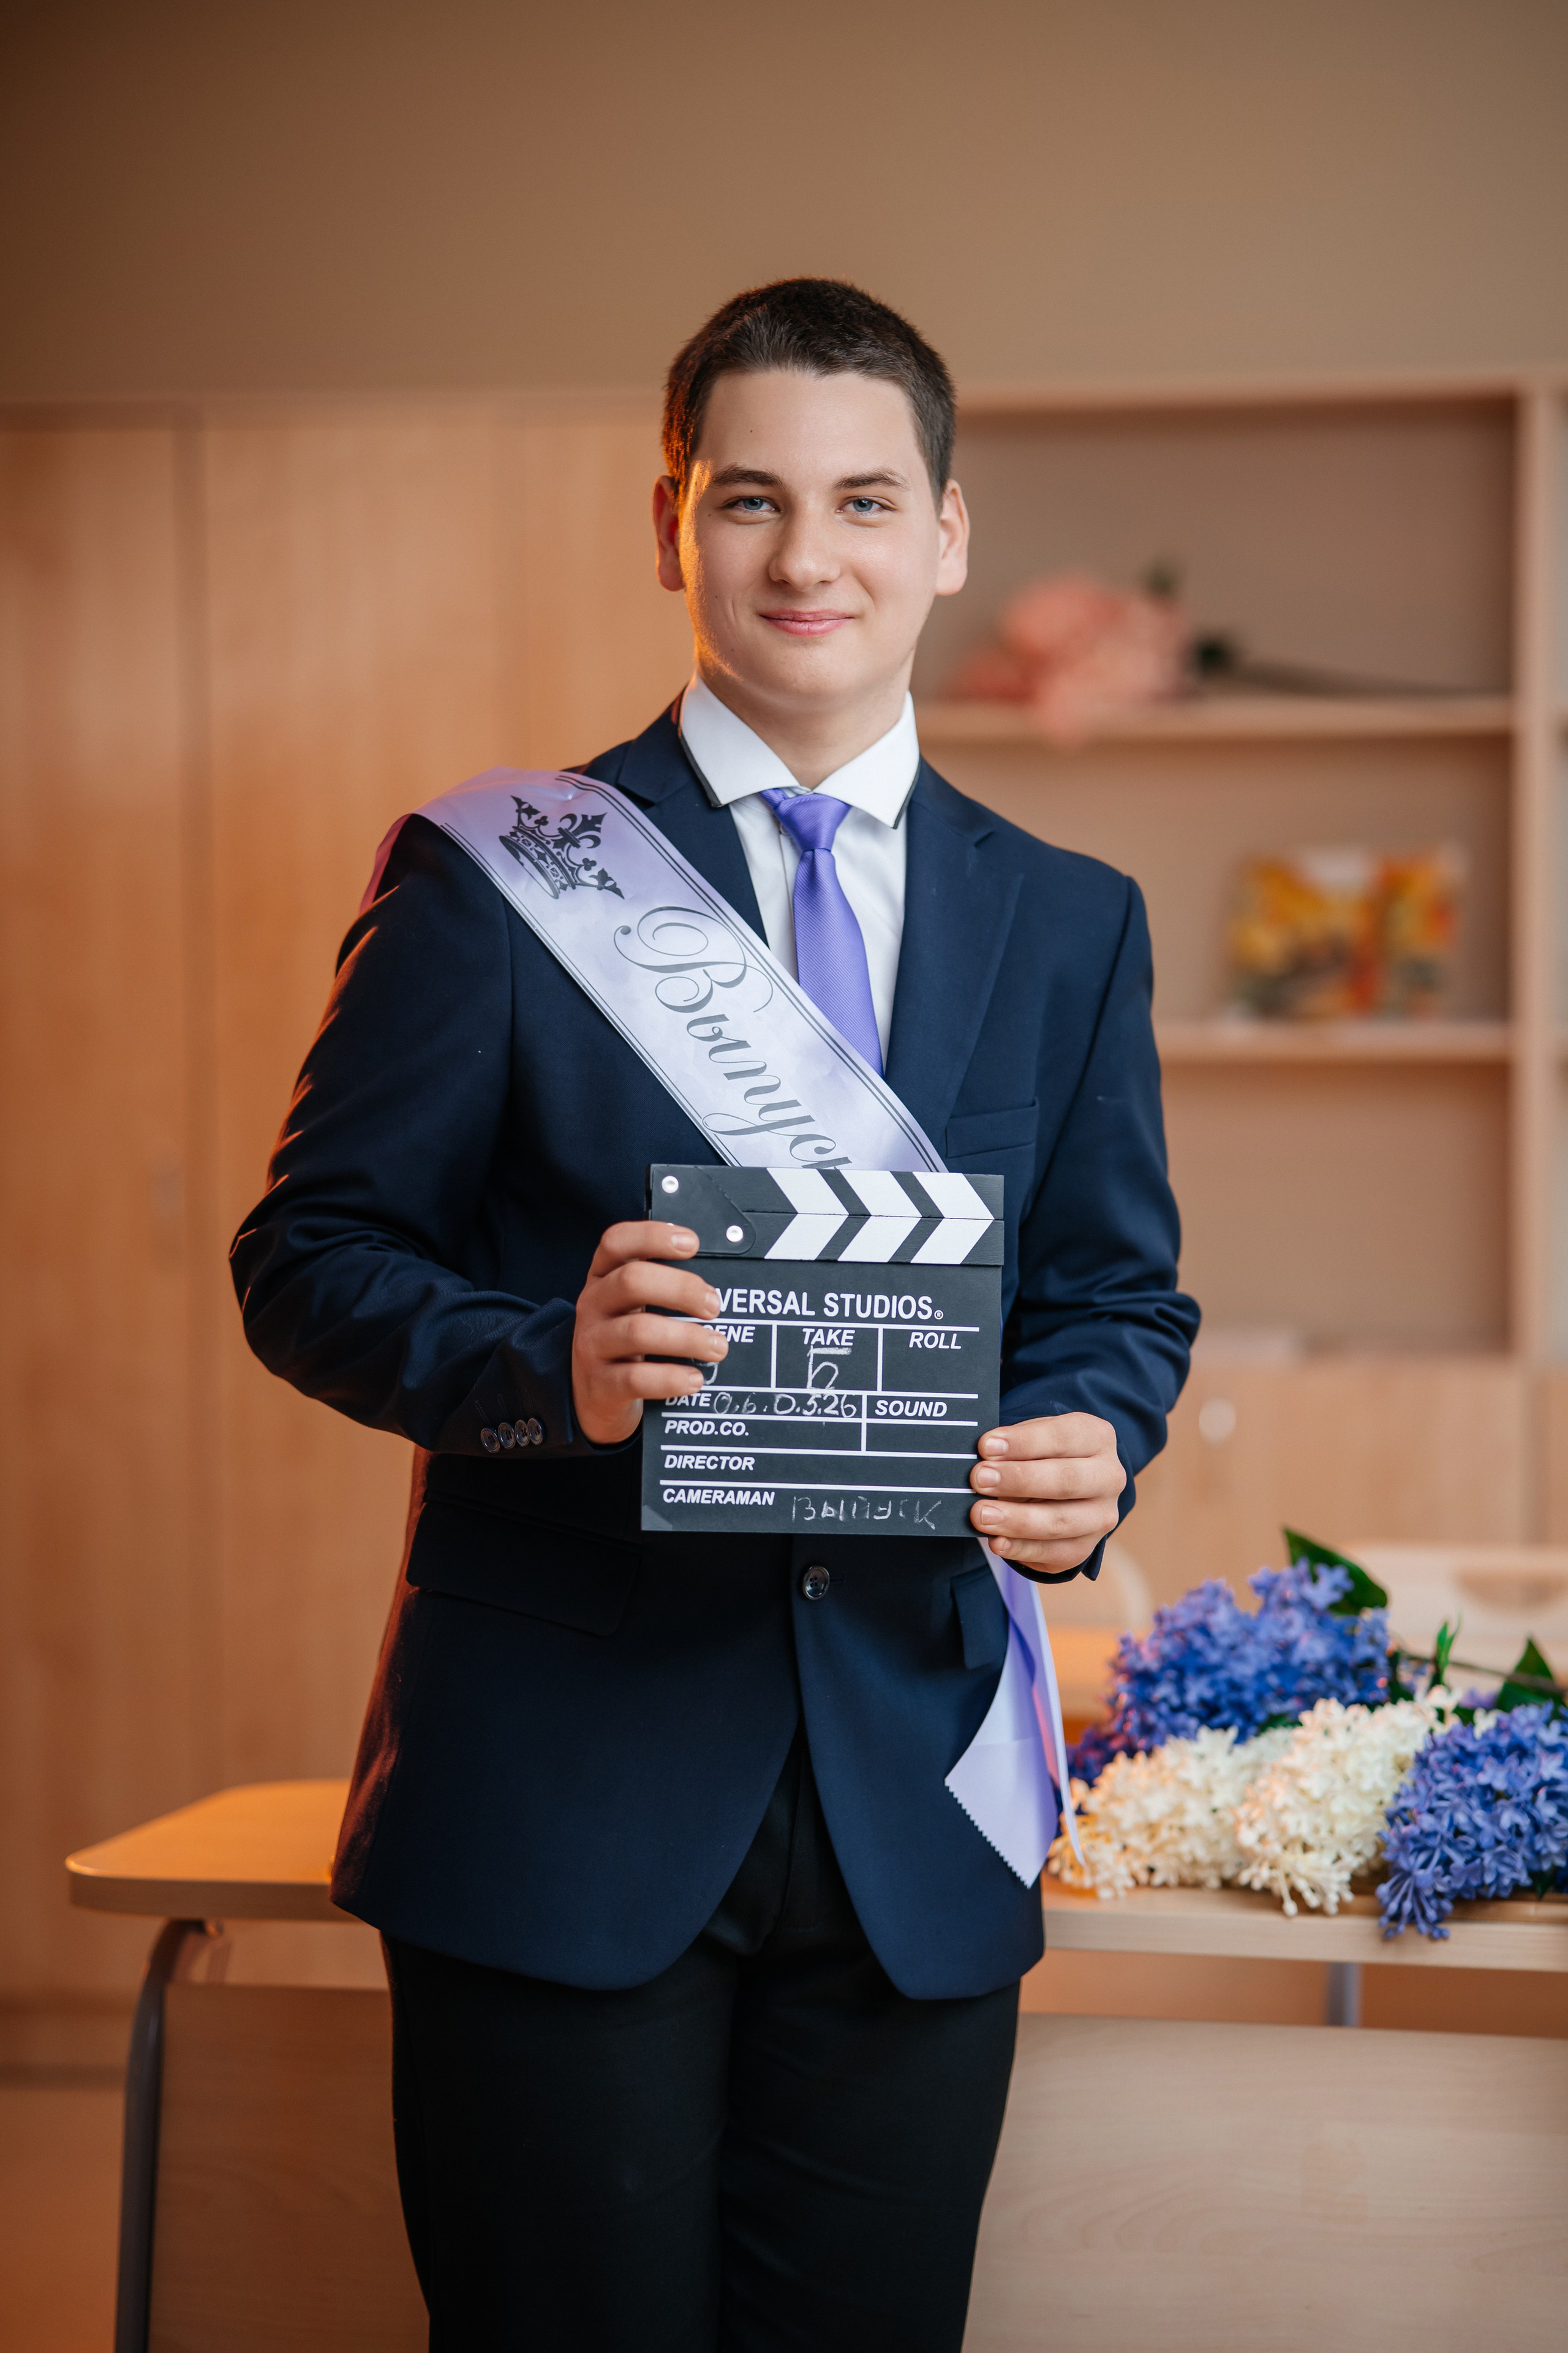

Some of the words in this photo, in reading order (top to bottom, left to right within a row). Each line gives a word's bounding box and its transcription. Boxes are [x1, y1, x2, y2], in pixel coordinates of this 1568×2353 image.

[715, 1288, 816, 1316] VERSAL
[802, 1328, 855, 1346] TAKE
[909, 1332, 962, 1349] ROLL
[665, 1392, 712, 1407] DATE
[875, 1400, 948, 1417] SOUND
[665, 1420, 749, 1437] PROD.CO.
[664, 1454, 755, 1471] DIRECTOR
[663, 1488, 775, 1506] CAMERAMAN
